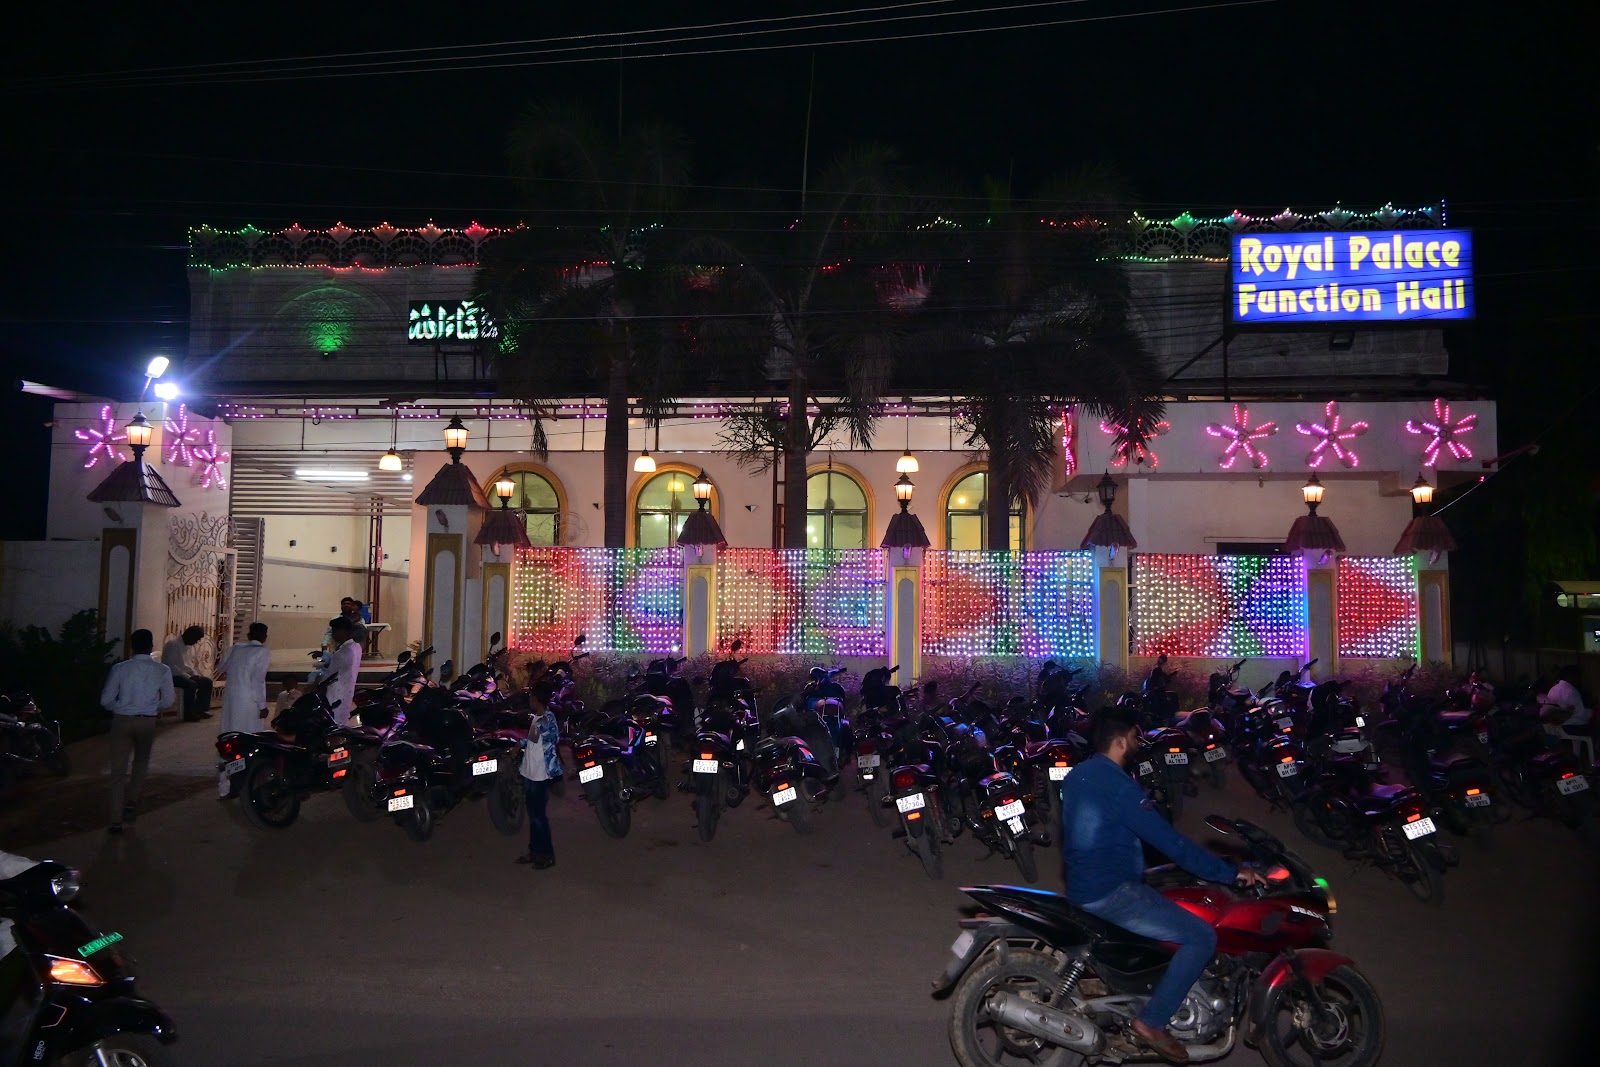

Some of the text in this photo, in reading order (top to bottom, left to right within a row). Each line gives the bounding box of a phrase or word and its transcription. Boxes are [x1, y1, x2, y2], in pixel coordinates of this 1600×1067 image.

[1239, 234, 1461, 280] Royal Palace
[1238, 279, 1466, 317] Function Hall
[32, 1039, 45, 1060] HERO
